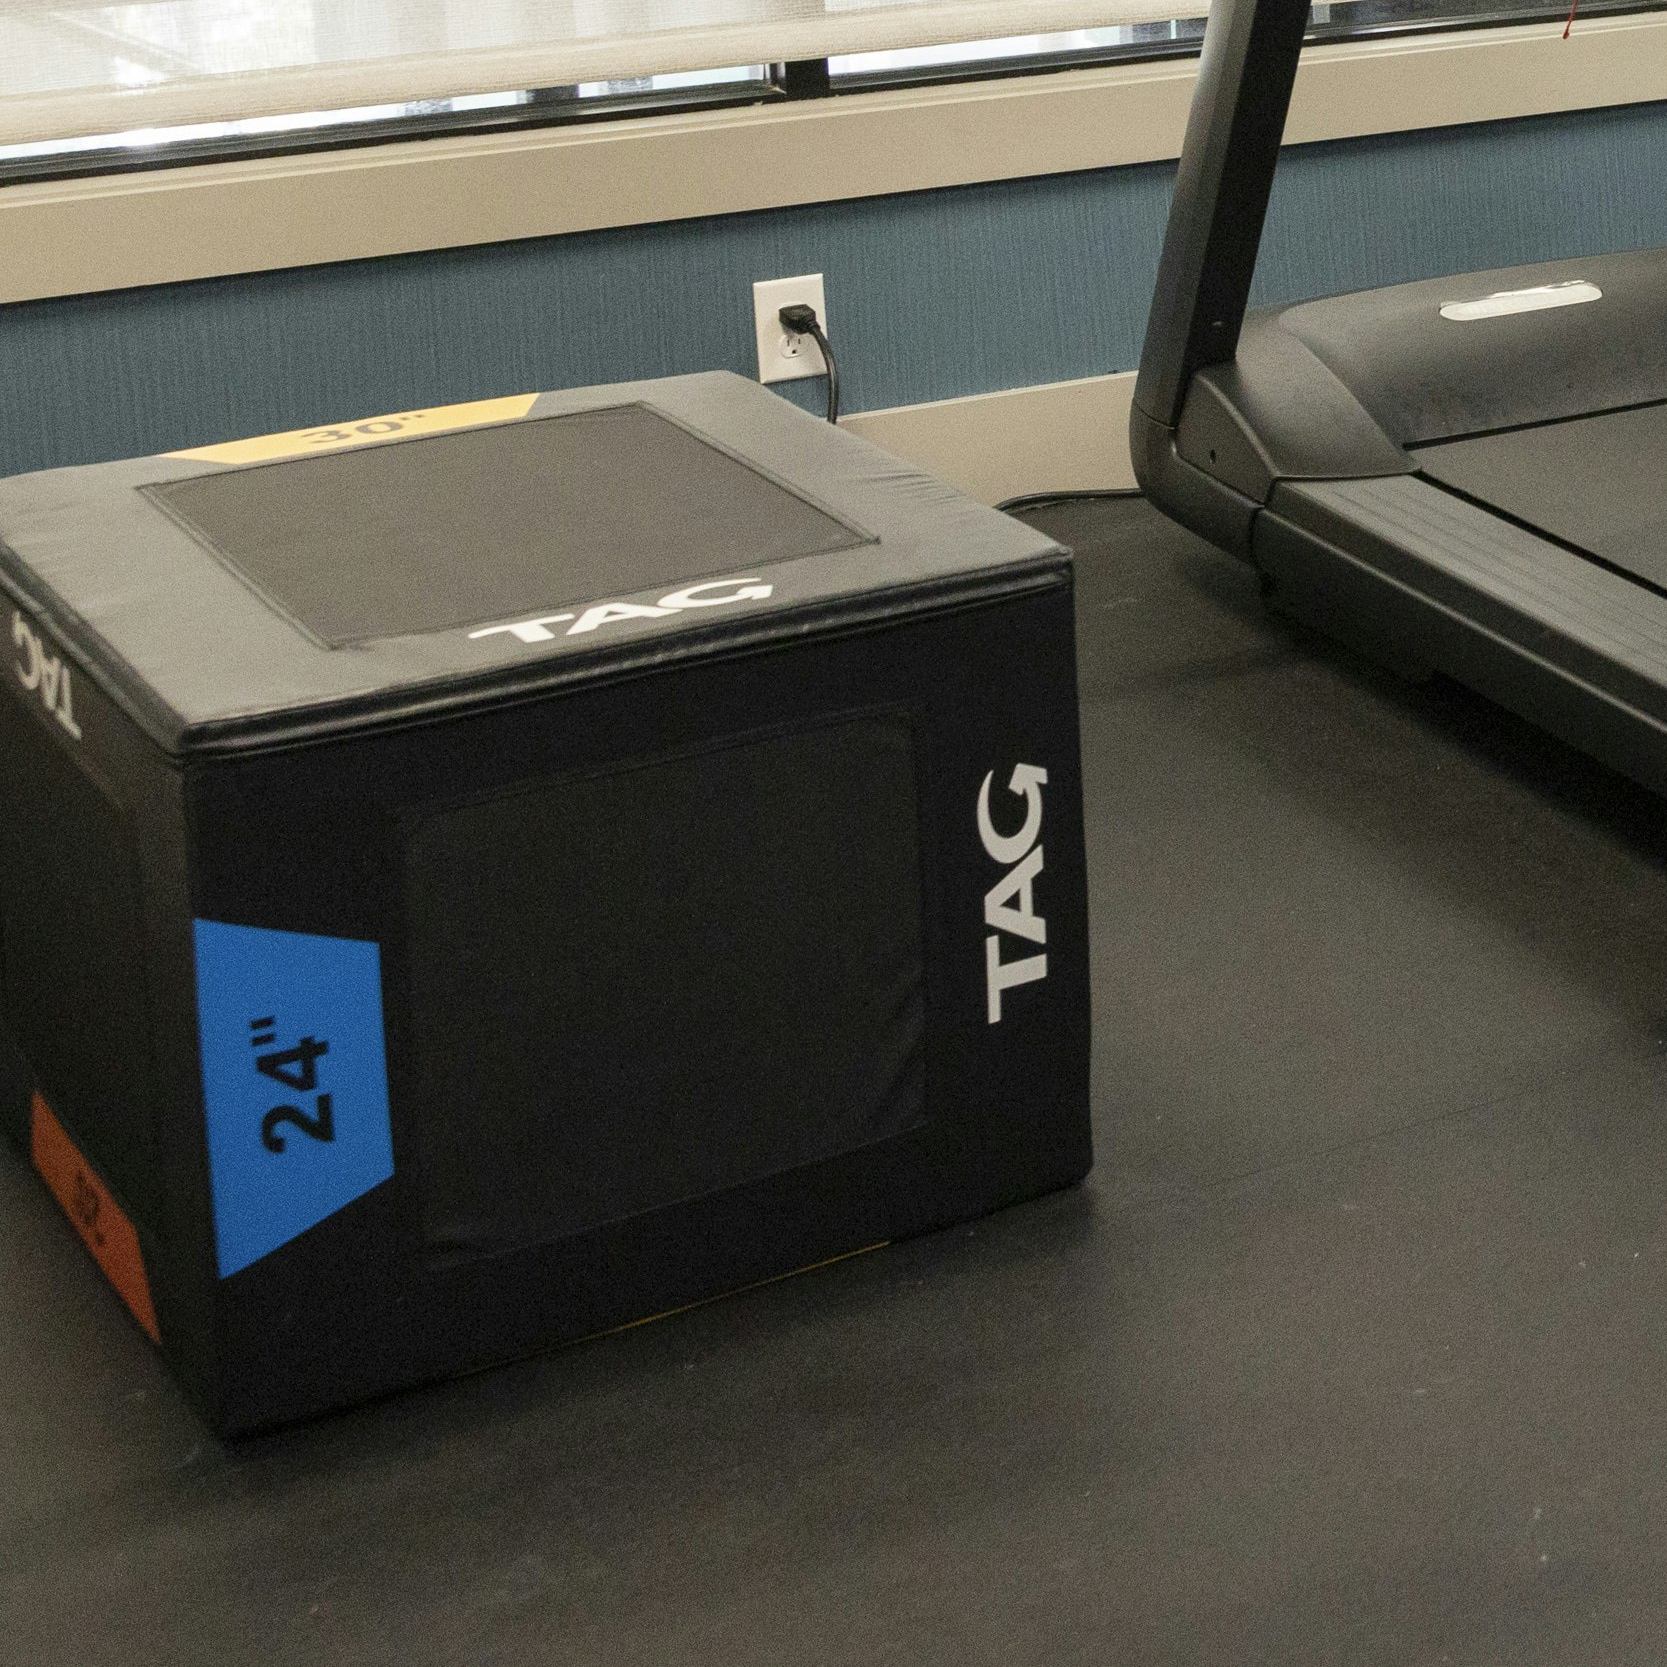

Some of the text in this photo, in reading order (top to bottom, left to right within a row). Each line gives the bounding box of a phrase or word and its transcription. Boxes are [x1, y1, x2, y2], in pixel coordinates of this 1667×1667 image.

[299, 413, 426, 445] 30"
[468, 577, 774, 644] TAG
[976, 762, 1048, 1026] TAG
[250, 1015, 336, 1155] 24"
